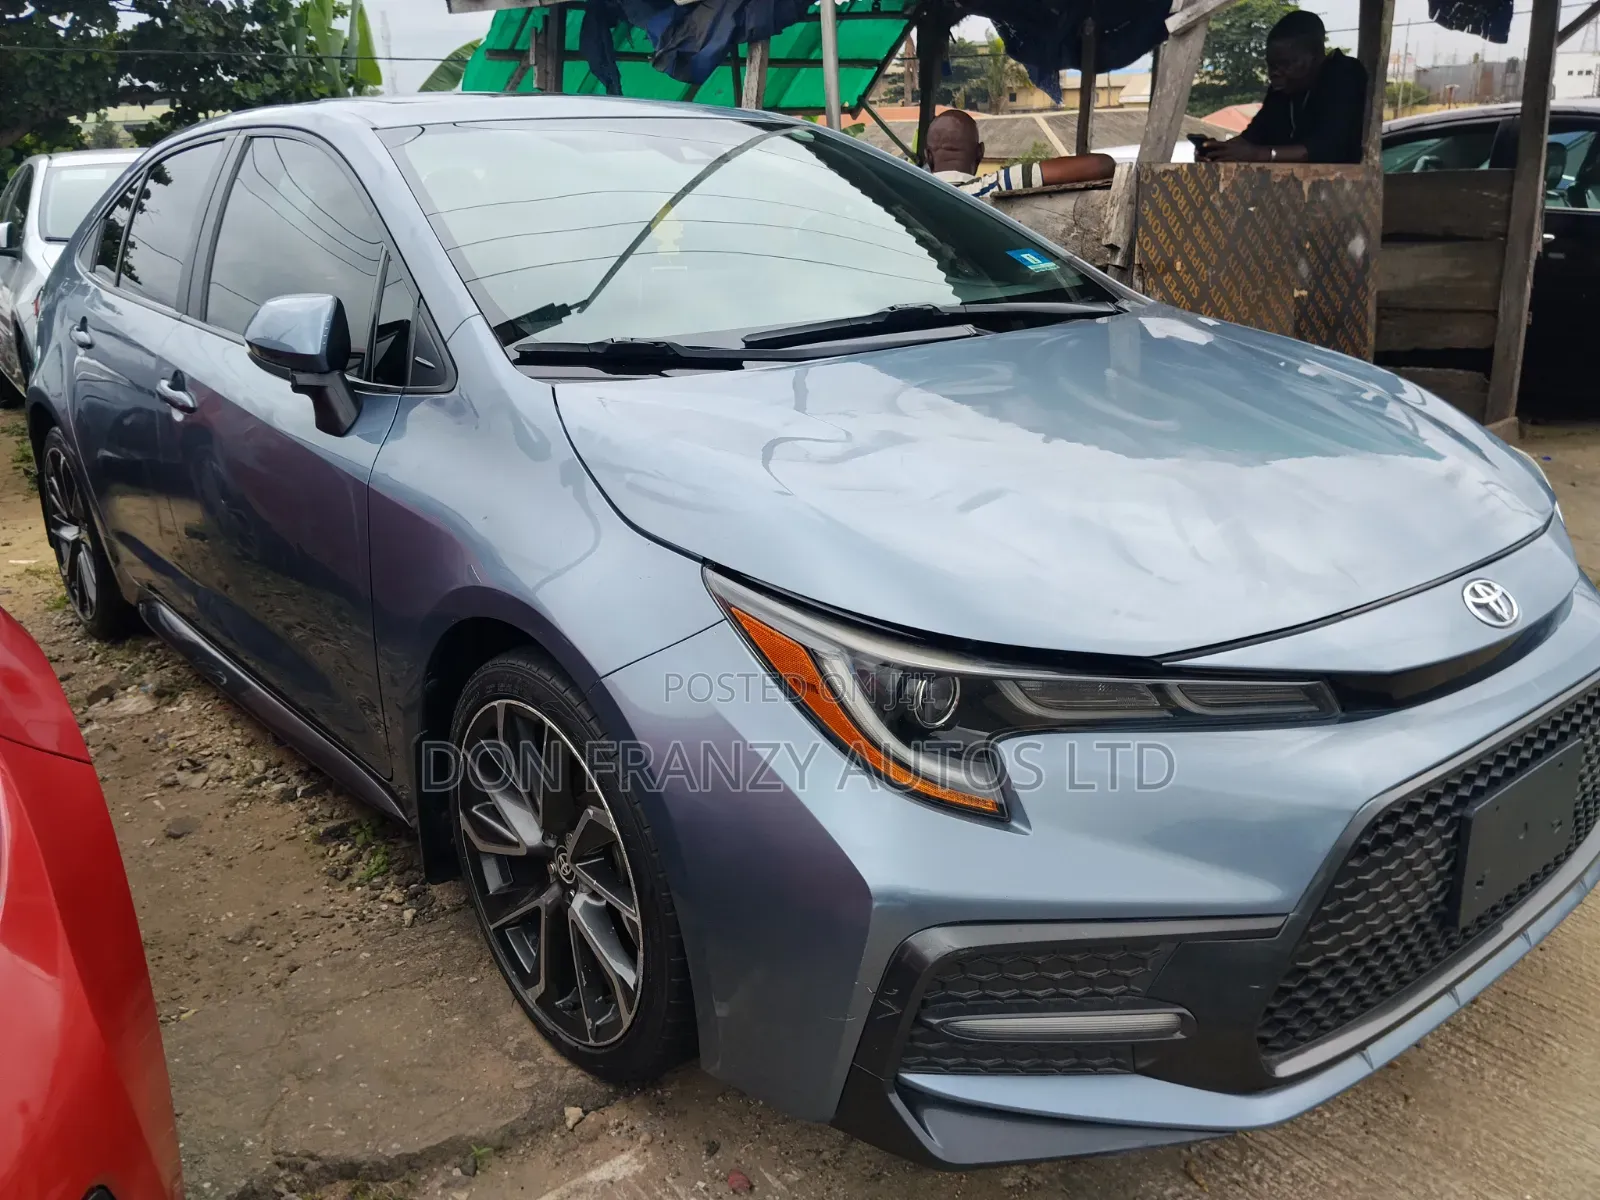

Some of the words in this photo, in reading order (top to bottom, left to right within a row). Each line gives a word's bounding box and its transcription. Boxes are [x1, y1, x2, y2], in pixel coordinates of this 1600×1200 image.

[1191, 221, 1218, 265] SUPER
[1200, 204, 1227, 249] SUPER
[1135, 225, 1166, 273] STRON
[1181, 237, 1209, 281] SUPER
[1208, 285, 1234, 322] UALITY
